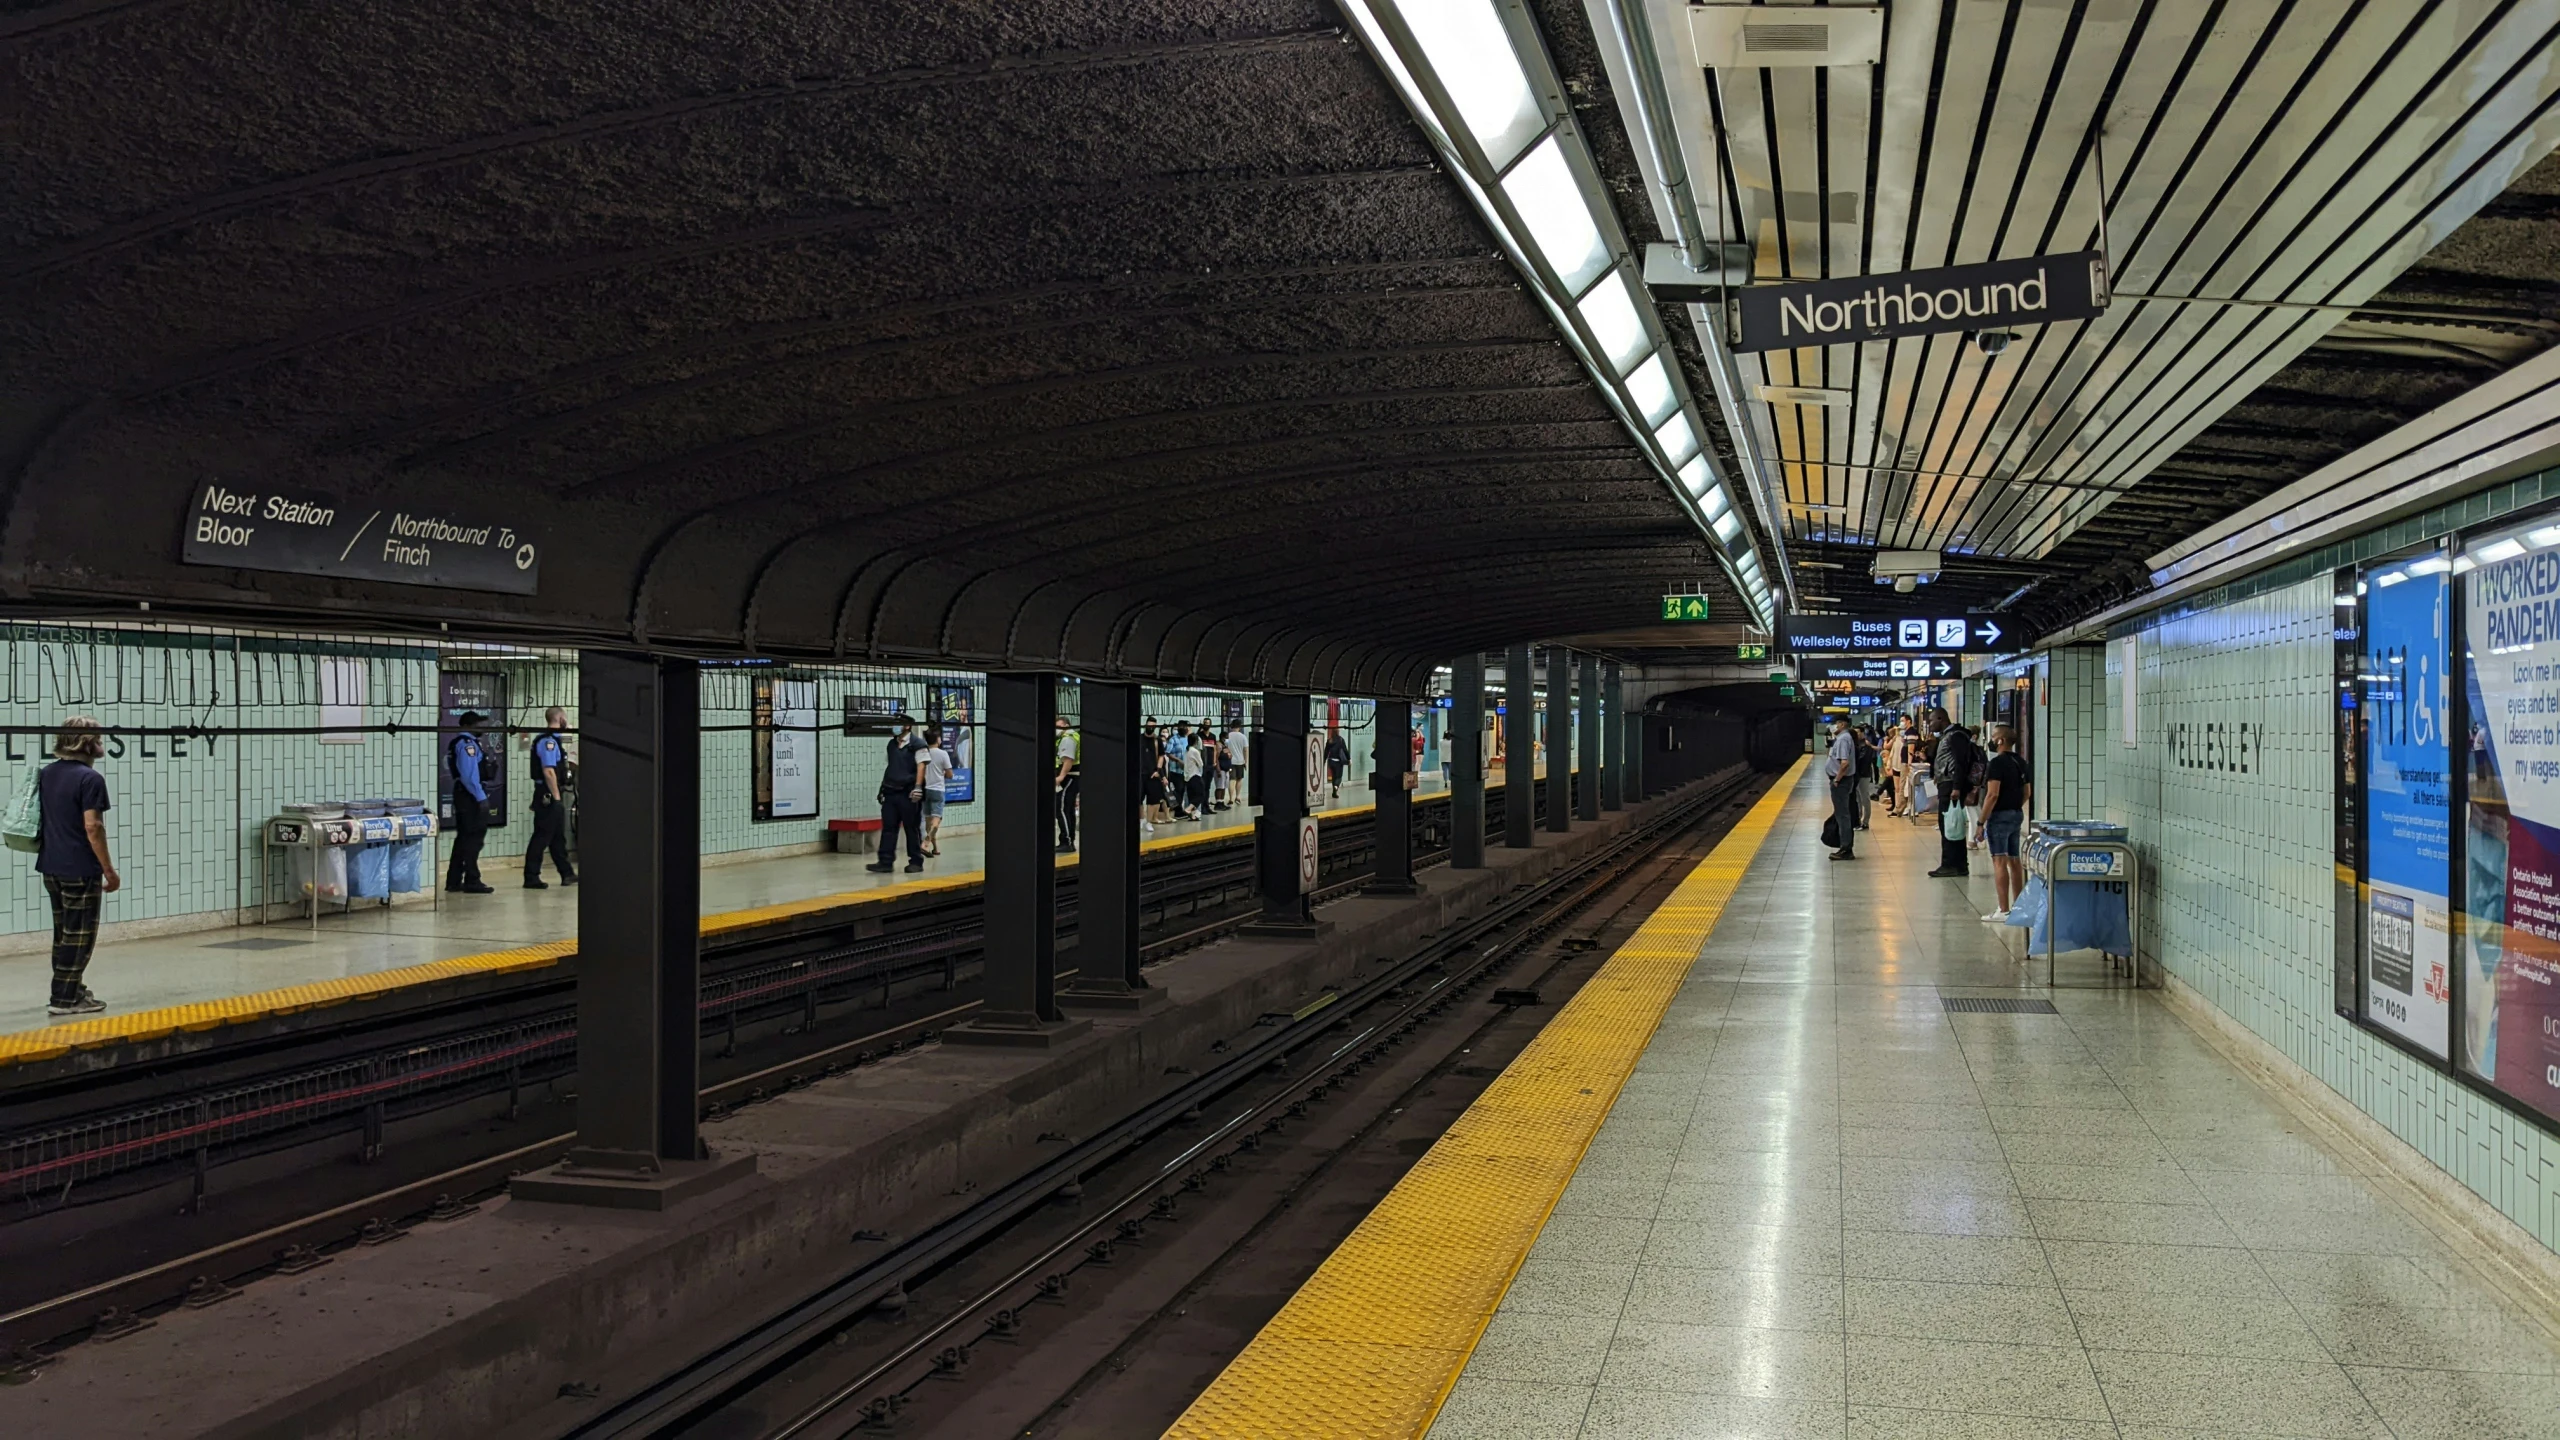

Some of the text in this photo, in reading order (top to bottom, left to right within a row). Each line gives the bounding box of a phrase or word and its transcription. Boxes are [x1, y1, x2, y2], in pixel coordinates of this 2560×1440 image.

[1780, 267, 2046, 337] Northbound
[203, 486, 334, 527] Next Station
[196, 517, 254, 546] Bloor
[390, 514, 515, 549] Northbound To
[383, 540, 430, 567] Finch
[2484, 552, 2560, 606] WORKED
[6, 626, 118, 645] WELLESLEY
[1852, 621, 1892, 632] Buses
[1791, 636, 1891, 649] Wellesley Street
[1828, 670, 1863, 678] Wellesley
[1864, 661, 1887, 669] Buses
[2513, 659, 2534, 683] Look
[2536, 665, 2550, 682] me
[2508, 698, 2526, 720] eyes
[2528, 689, 2544, 713] and
[2509, 721, 2541, 745] deserve
[2544, 725, 2554, 745] to
[776, 747, 793, 760] until
[2167, 722, 2262, 775] WELLESLEY
[776, 764, 781, 777] it
[2515, 760, 2559, 784] my wages
[326, 823, 342, 832] Litter
[2070, 853, 2100, 863] Recycle
[2513, 867, 2553, 888] Ontario Hospital
[2513, 884, 2541, 903] Association,
[2513, 903, 2516, 912] a
[2517, 901, 2532, 916] better
[2533, 908, 2555, 922] outcome
[2534, 922, 2546, 937] staff
[2547, 927, 2557, 940] and
